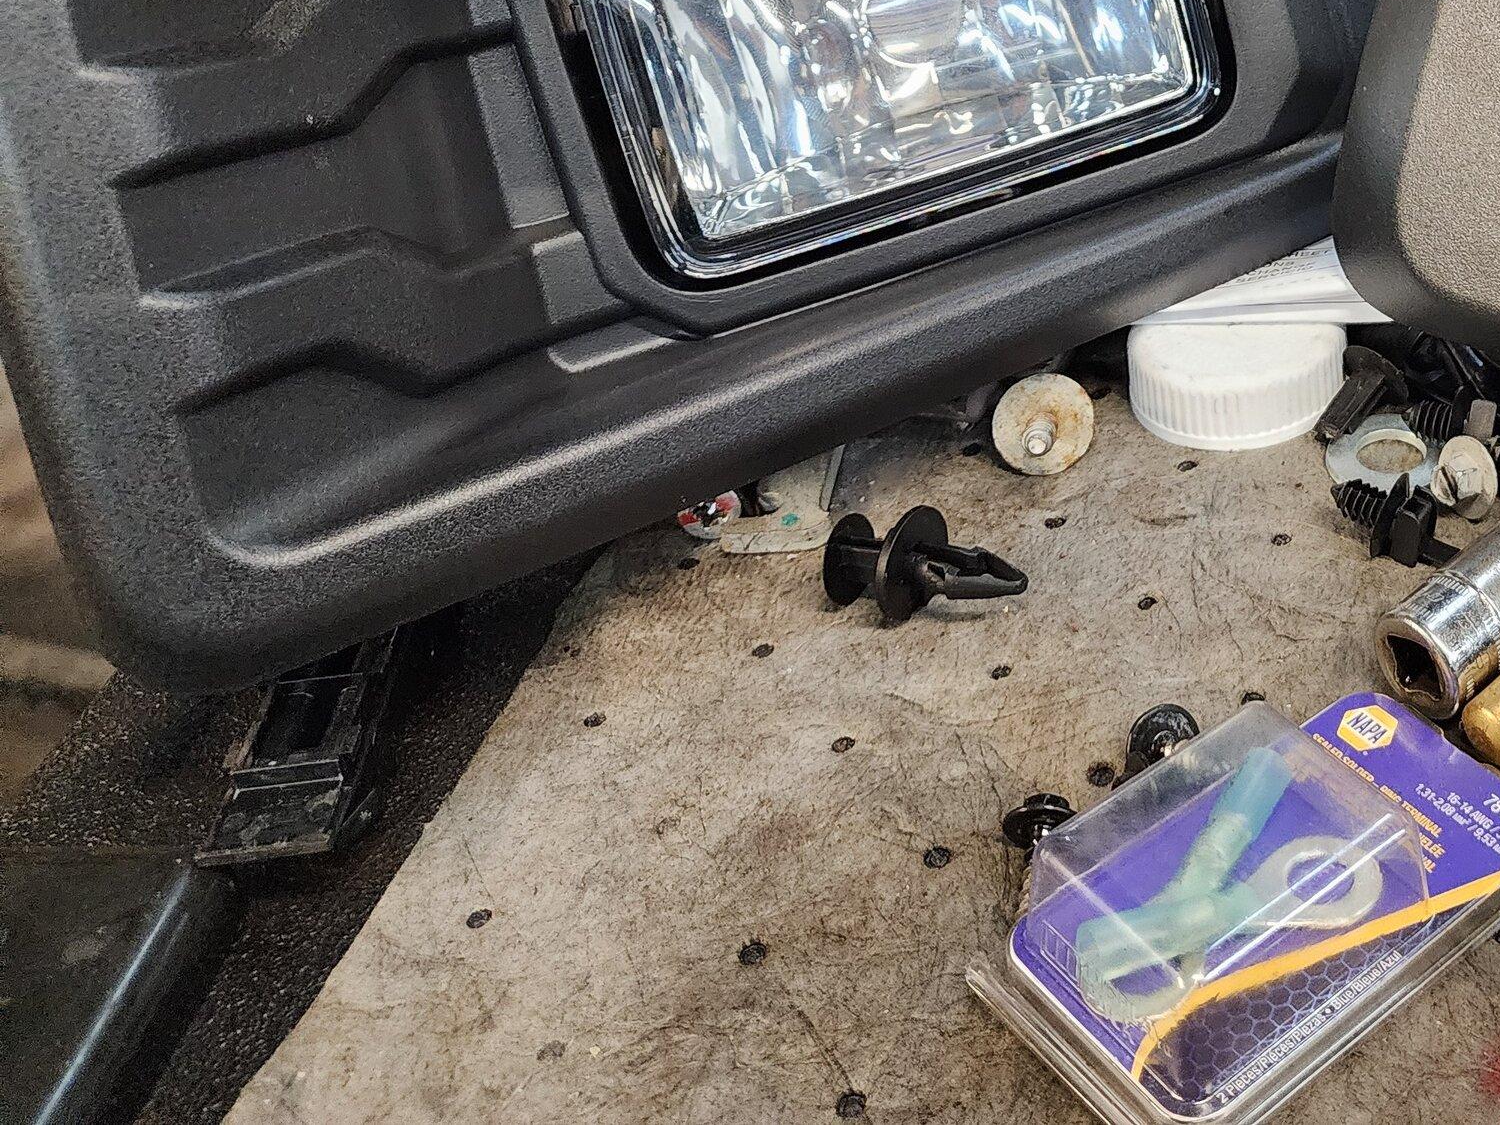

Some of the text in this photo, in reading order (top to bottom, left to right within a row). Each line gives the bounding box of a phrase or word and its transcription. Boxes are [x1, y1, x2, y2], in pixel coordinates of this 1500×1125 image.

[1347, 712, 1388, 744] NAPA
[1401, 800, 1443, 837] TERMINAL
[1447, 791, 1473, 814] 16-14
[1470, 809, 1491, 828] AWG
[1216, 1090, 1229, 1103] 2
